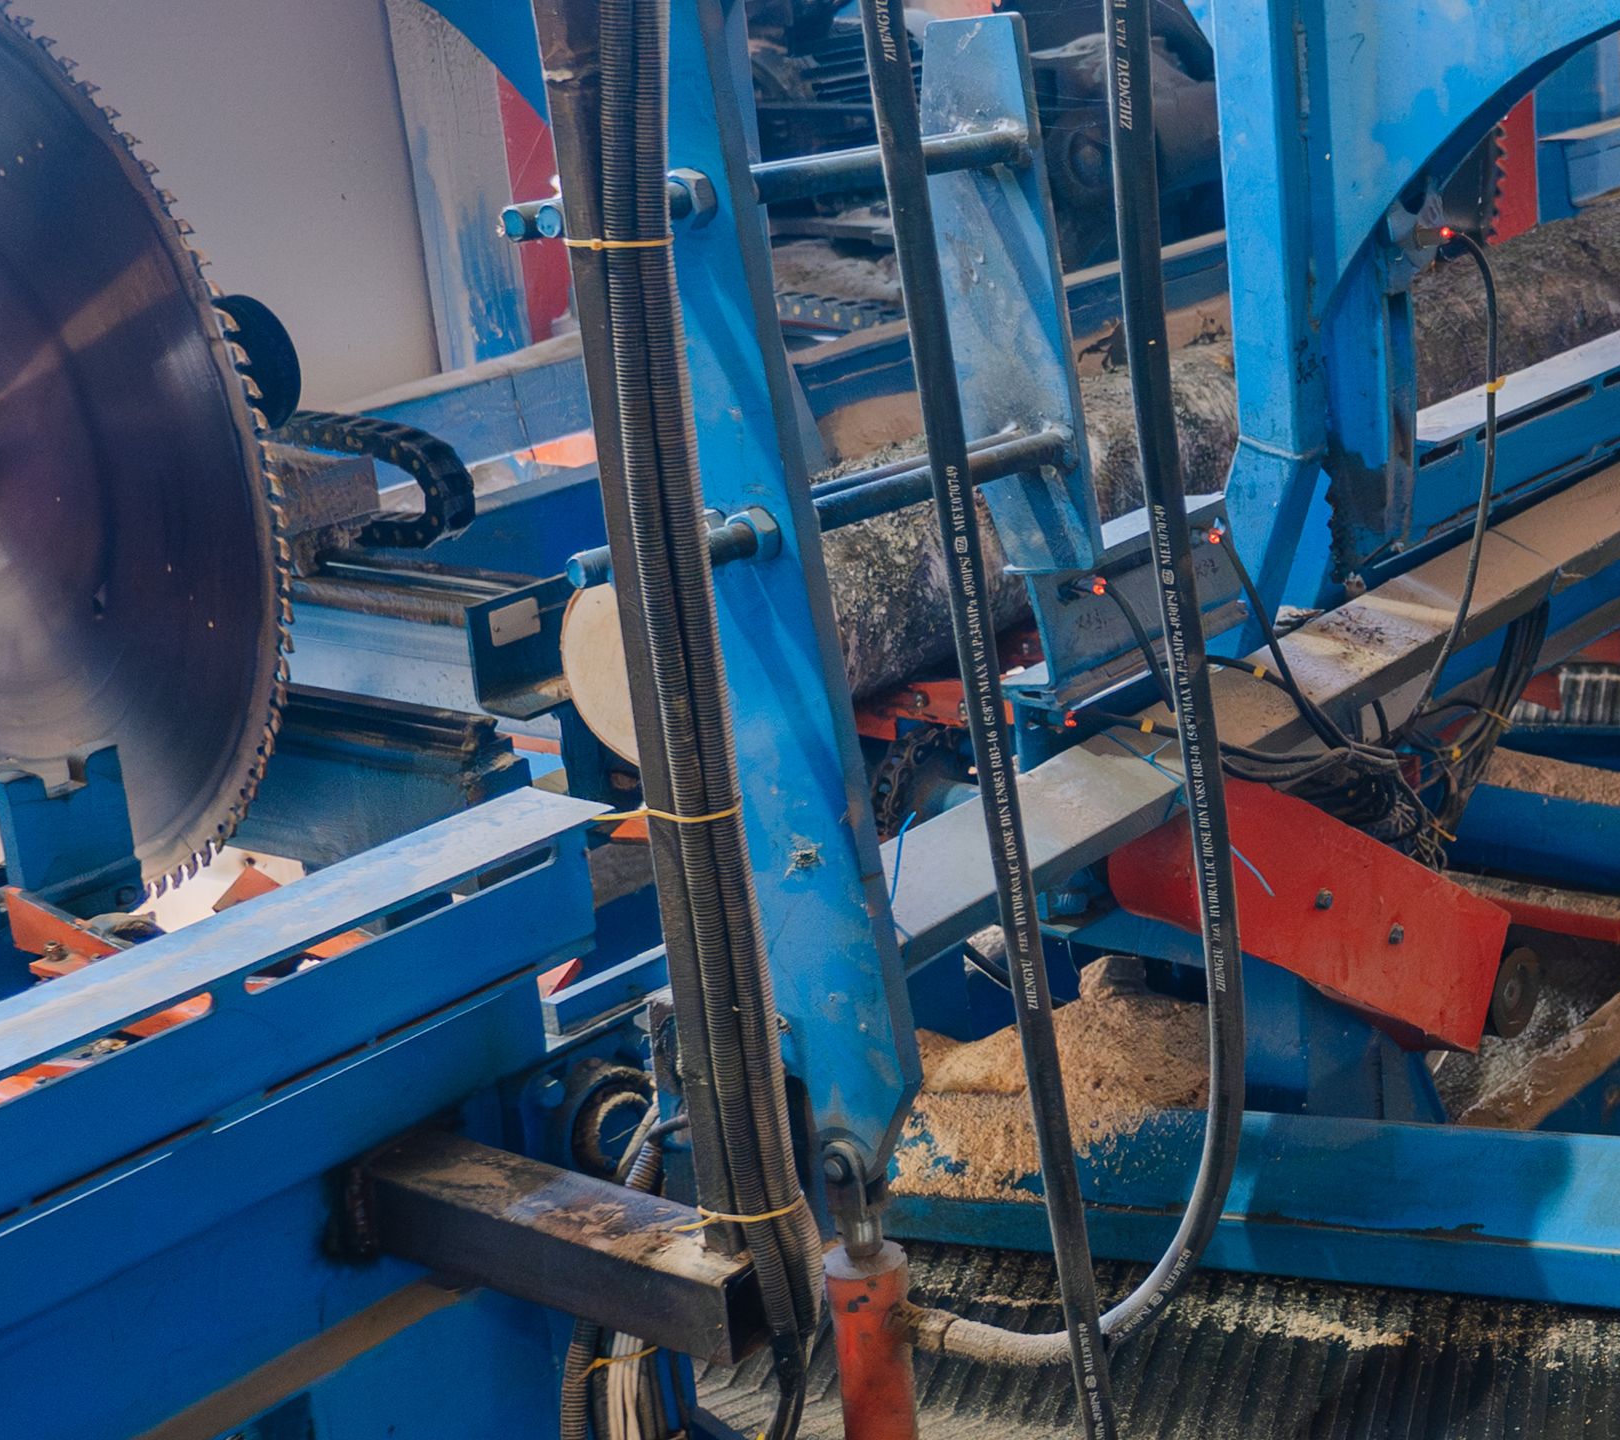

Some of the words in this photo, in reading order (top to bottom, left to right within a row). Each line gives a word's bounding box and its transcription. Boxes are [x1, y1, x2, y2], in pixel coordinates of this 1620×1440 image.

[1116, 19, 1126, 48] FLEX
[1117, 57, 1132, 130] ZHENGYU
[946, 466, 965, 531] MEE070749
[1154, 505, 1172, 566] MEE070749
[976, 664, 990, 692] MAX
[1181, 689, 1193, 711] MAX
[987, 731, 1003, 768] RB3-16
[1190, 745, 1203, 777] RB3-16
[993, 771, 1008, 803] EN853
[999, 806, 1012, 827] DIN
[1198, 811, 1210, 828] DIN
[1003, 829, 1017, 860] HOSE
[1201, 831, 1214, 857] HOSE
[1009, 862, 1026, 925] HYDRAULIC
[1203, 859, 1220, 918] HYDRAULIC
[1020, 959, 1039, 1009] ZHENGYU
[1213, 950, 1226, 992] ZHENGYU
